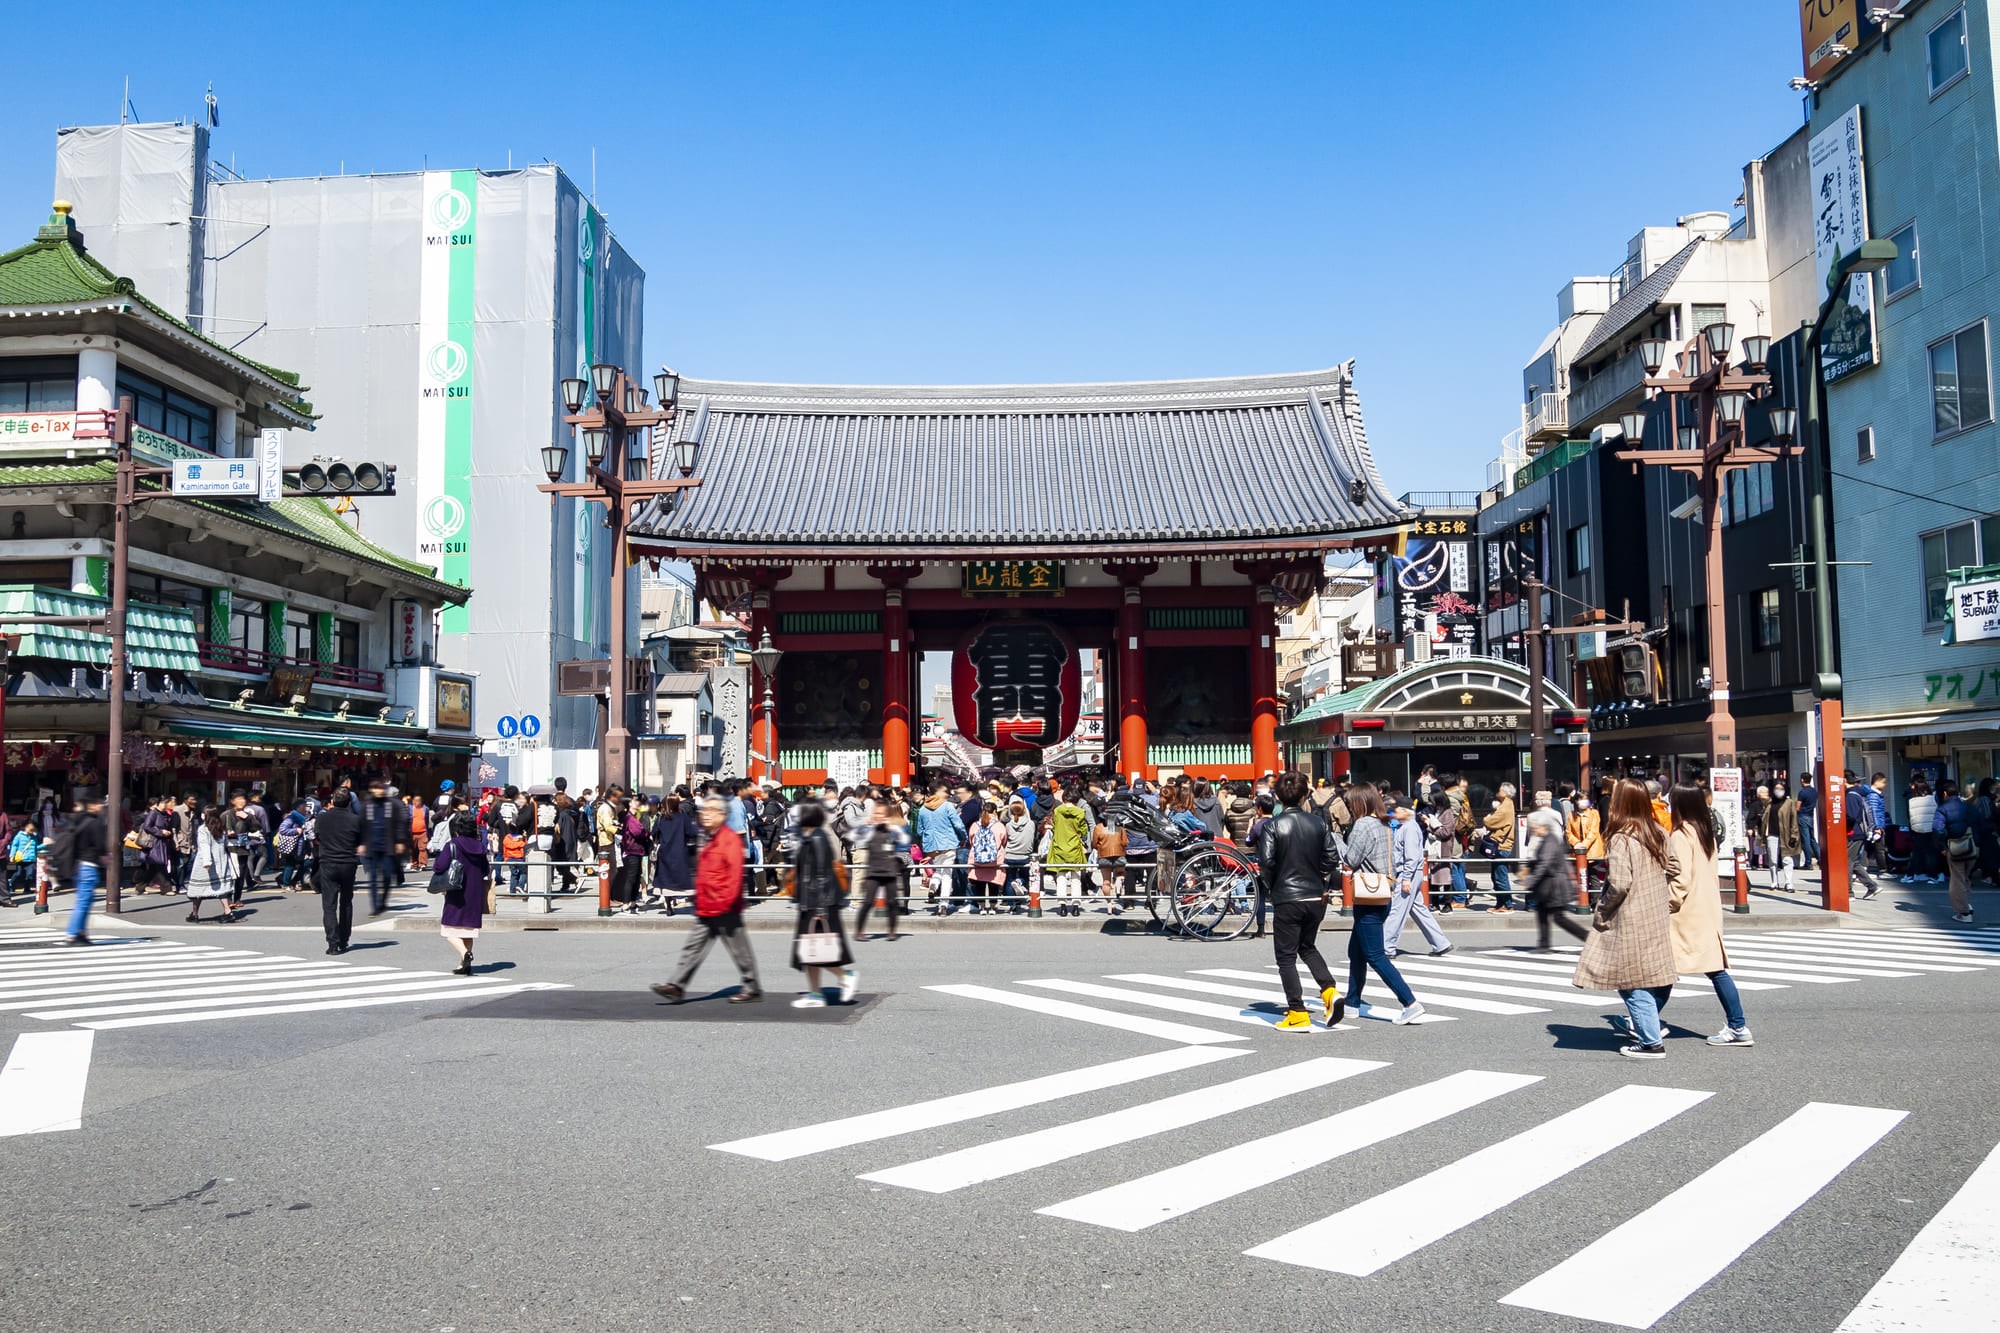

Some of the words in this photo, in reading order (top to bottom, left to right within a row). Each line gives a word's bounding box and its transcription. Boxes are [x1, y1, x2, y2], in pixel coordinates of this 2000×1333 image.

[1846, 117, 1865, 301] 良質な抹茶は苦ない。
[426, 234, 472, 246] MATSUI
[423, 386, 468, 398] MATSUI
[264, 431, 278, 498] スクランブル式
[180, 483, 230, 491] Kaminarimon
[232, 482, 250, 490] Gate
[420, 542, 466, 553] MATSUI
[1961, 589, 1999, 608] 地下鉄
[1963, 605, 1998, 618] SUBWAY
[1462, 715, 1518, 728] 雷門交番
[1420, 735, 1476, 743] KAMINARIMON
